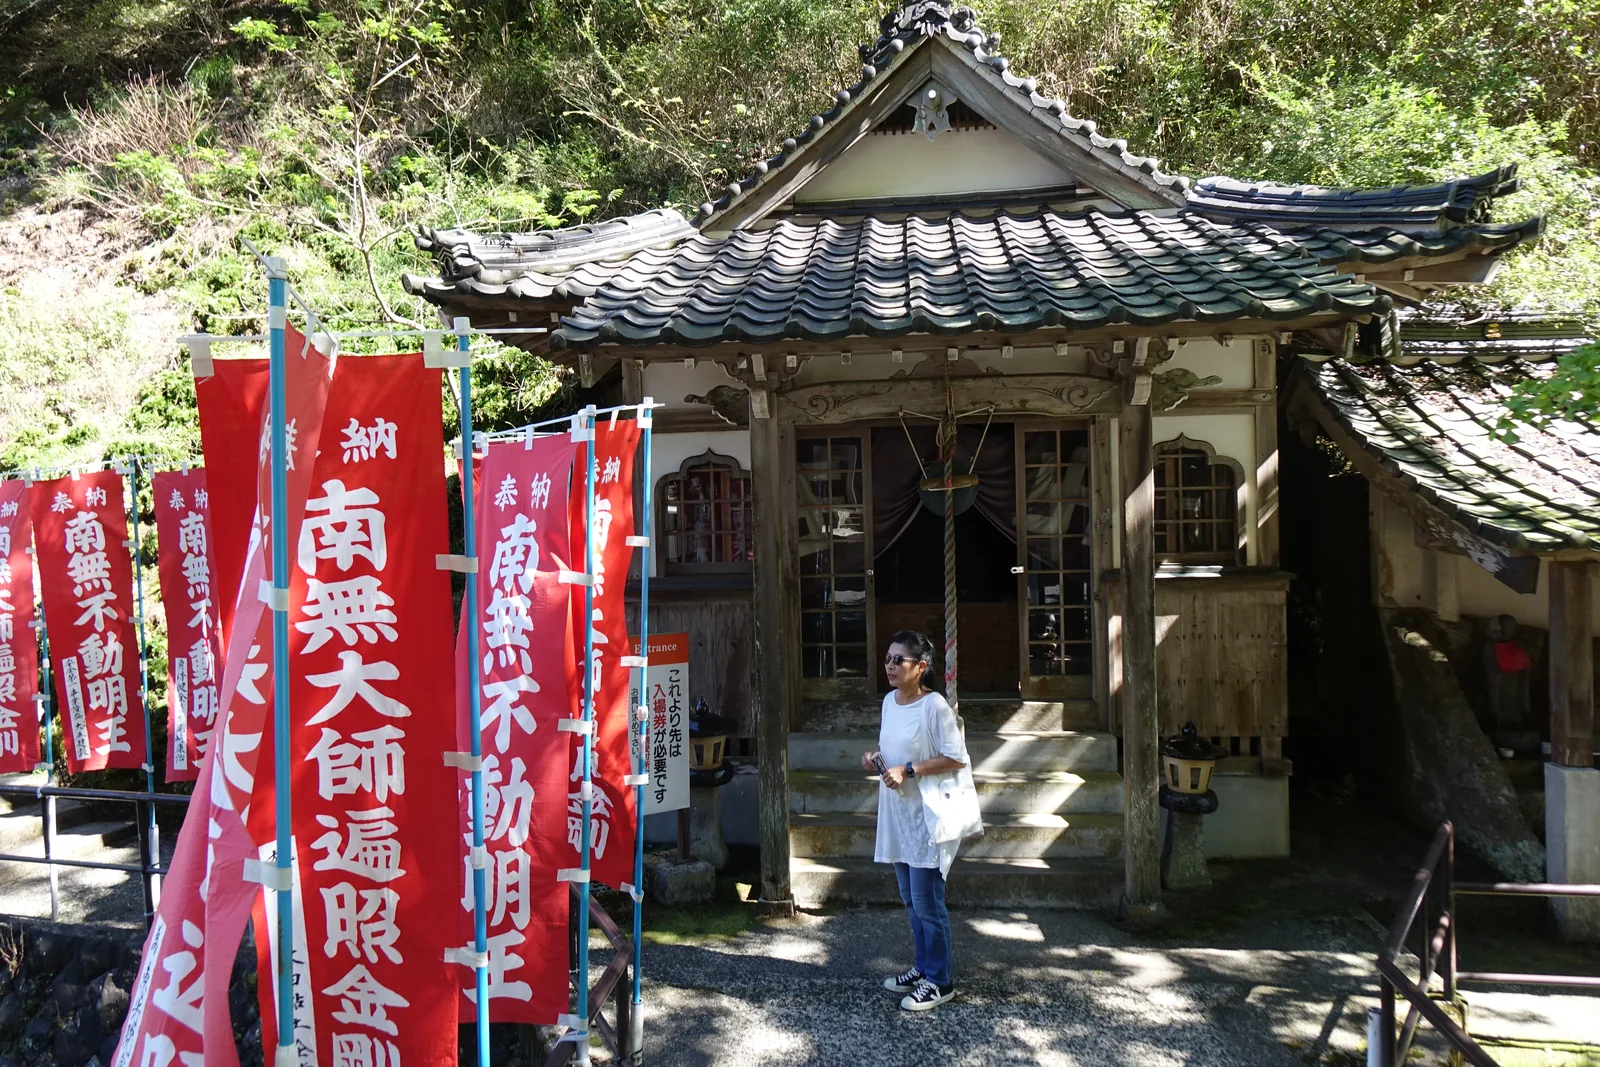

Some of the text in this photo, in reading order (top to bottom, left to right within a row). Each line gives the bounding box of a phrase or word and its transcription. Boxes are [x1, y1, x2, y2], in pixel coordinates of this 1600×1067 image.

[316, 417, 398, 465] 納
[51, 486, 108, 515] 奉納
[169, 487, 209, 511] 奉納
[494, 472, 552, 512] 奉納
[63, 510, 132, 757] 南無不動明王
[633, 643, 678, 654] Etrance
[668, 669, 682, 758] これより先は
[460, 512, 541, 1004] 南無不動明王
[652, 684, 668, 804] 入場券が必要です
